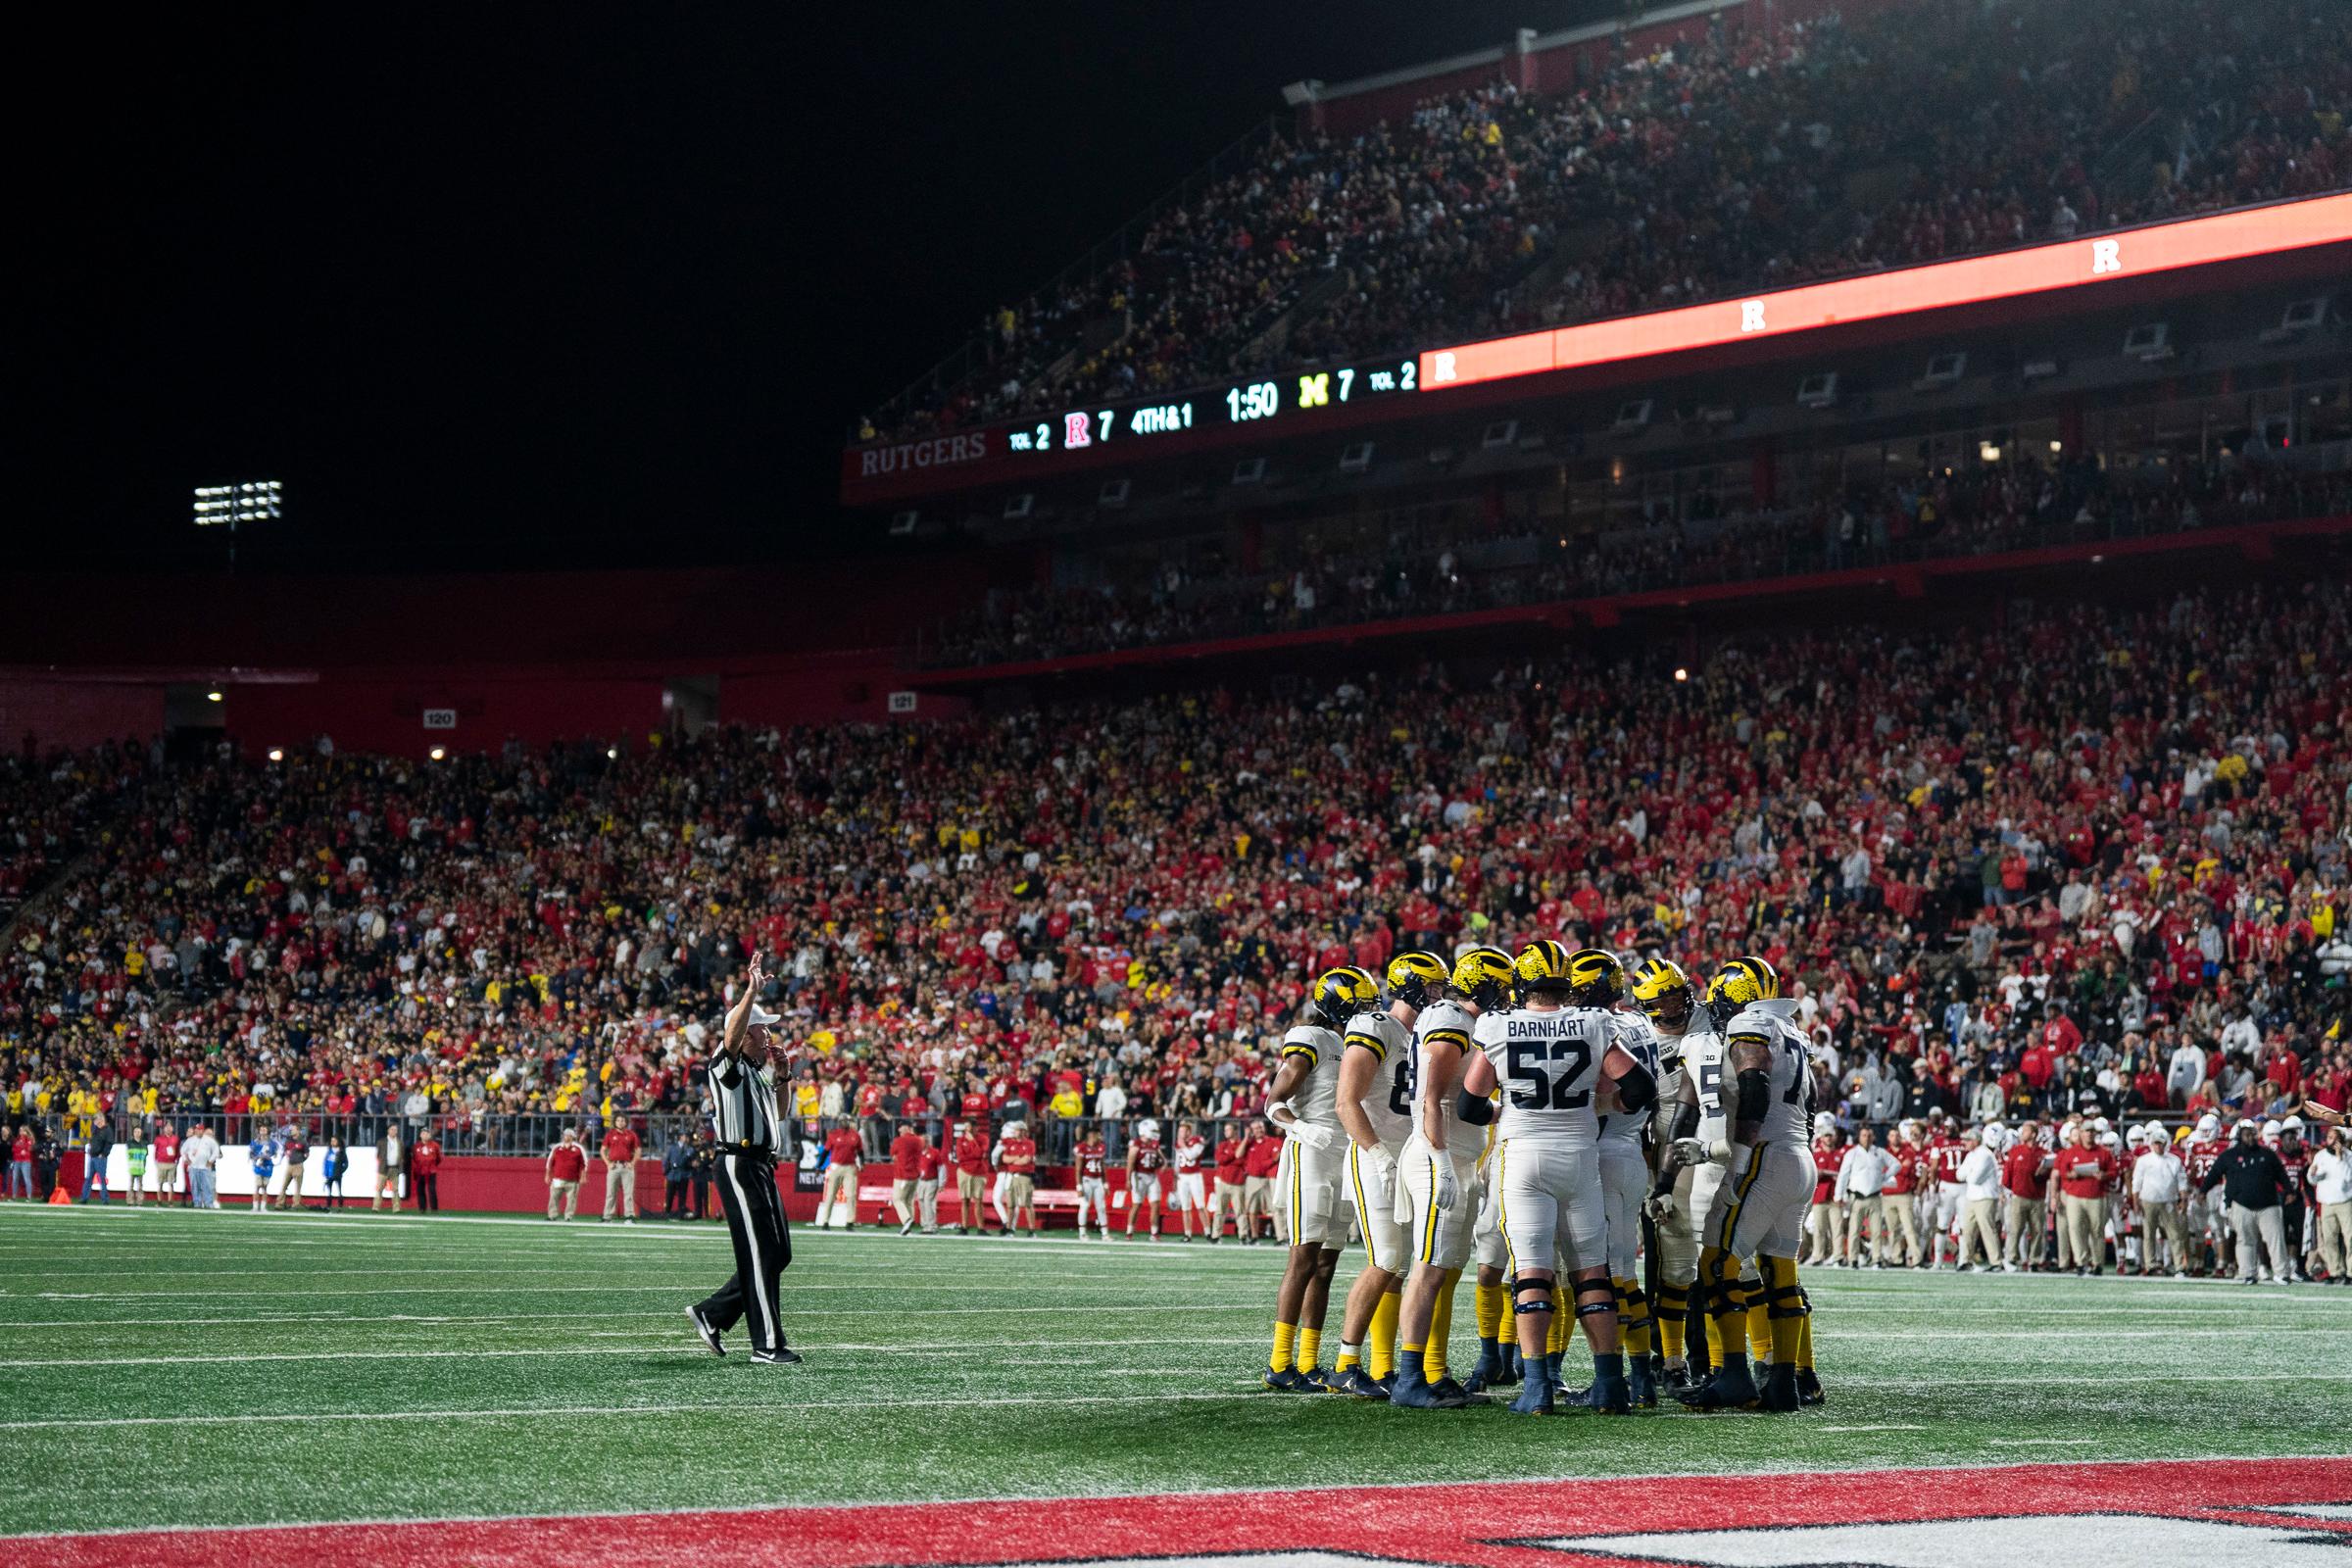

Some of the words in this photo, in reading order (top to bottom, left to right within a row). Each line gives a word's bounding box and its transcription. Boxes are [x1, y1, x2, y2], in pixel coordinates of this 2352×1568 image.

[2092, 239, 2122, 273] R
[1741, 300, 1766, 332] R
[1434, 352, 1456, 381] R
[1035, 423, 1050, 450] 2
[1064, 412, 1092, 449] R
[1098, 410, 1114, 441] 7
[1226, 381, 1278, 422] 1:50
[1298, 373, 1329, 408] M
[1338, 368, 1354, 402] 7
[1400, 361, 1416, 390] 2
[861, 432, 986, 477] RUTGERS
[894, 695, 911, 708] 121
[426, 712, 452, 725] 120
[1507, 1018, 1586, 1038] BARNHART
[1506, 1039, 1592, 1110] 52
[799, 1172, 826, 1184] NETW
